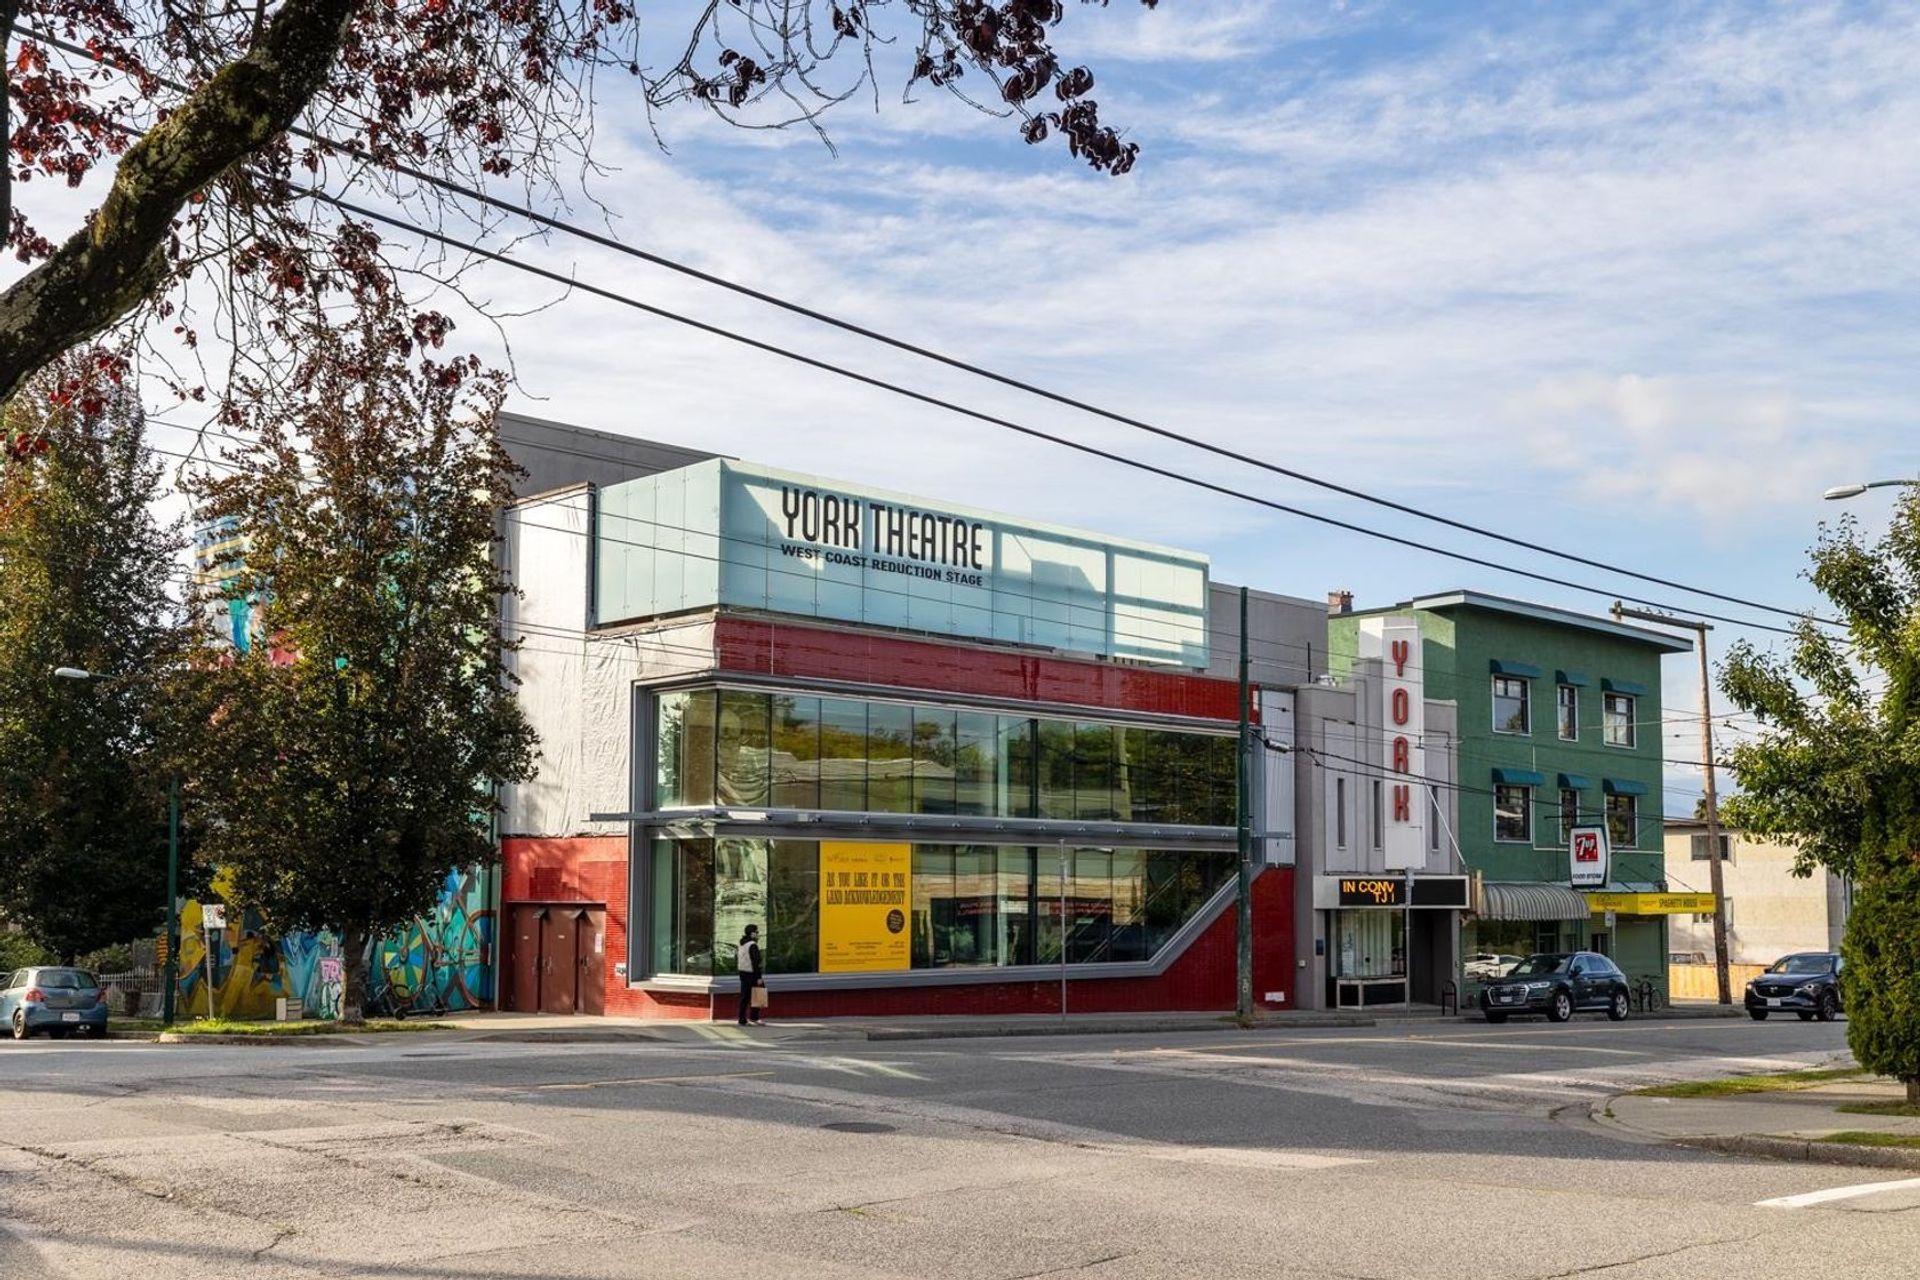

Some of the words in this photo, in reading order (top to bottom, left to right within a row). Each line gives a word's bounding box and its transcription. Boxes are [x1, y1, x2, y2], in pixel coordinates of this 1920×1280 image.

[782, 486, 860, 550] YORK
[869, 503, 983, 571] THEATRE
[780, 543, 820, 559] WEST
[825, 551, 868, 567] COAST
[871, 558, 942, 580] REDUCTION
[945, 571, 983, 587] STAGE
[1391, 640, 1409, 822] YORK
[826, 872, 836, 887] AS
[838, 872, 851, 887] YOU
[854, 872, 869, 887] LIKE
[871, 872, 879, 887] IT
[893, 872, 905, 888] THE
[1342, 881, 1356, 893] IN
[826, 889, 843, 905] LAND
[844, 890, 905, 905] ACKNOWLEDGEMENT
